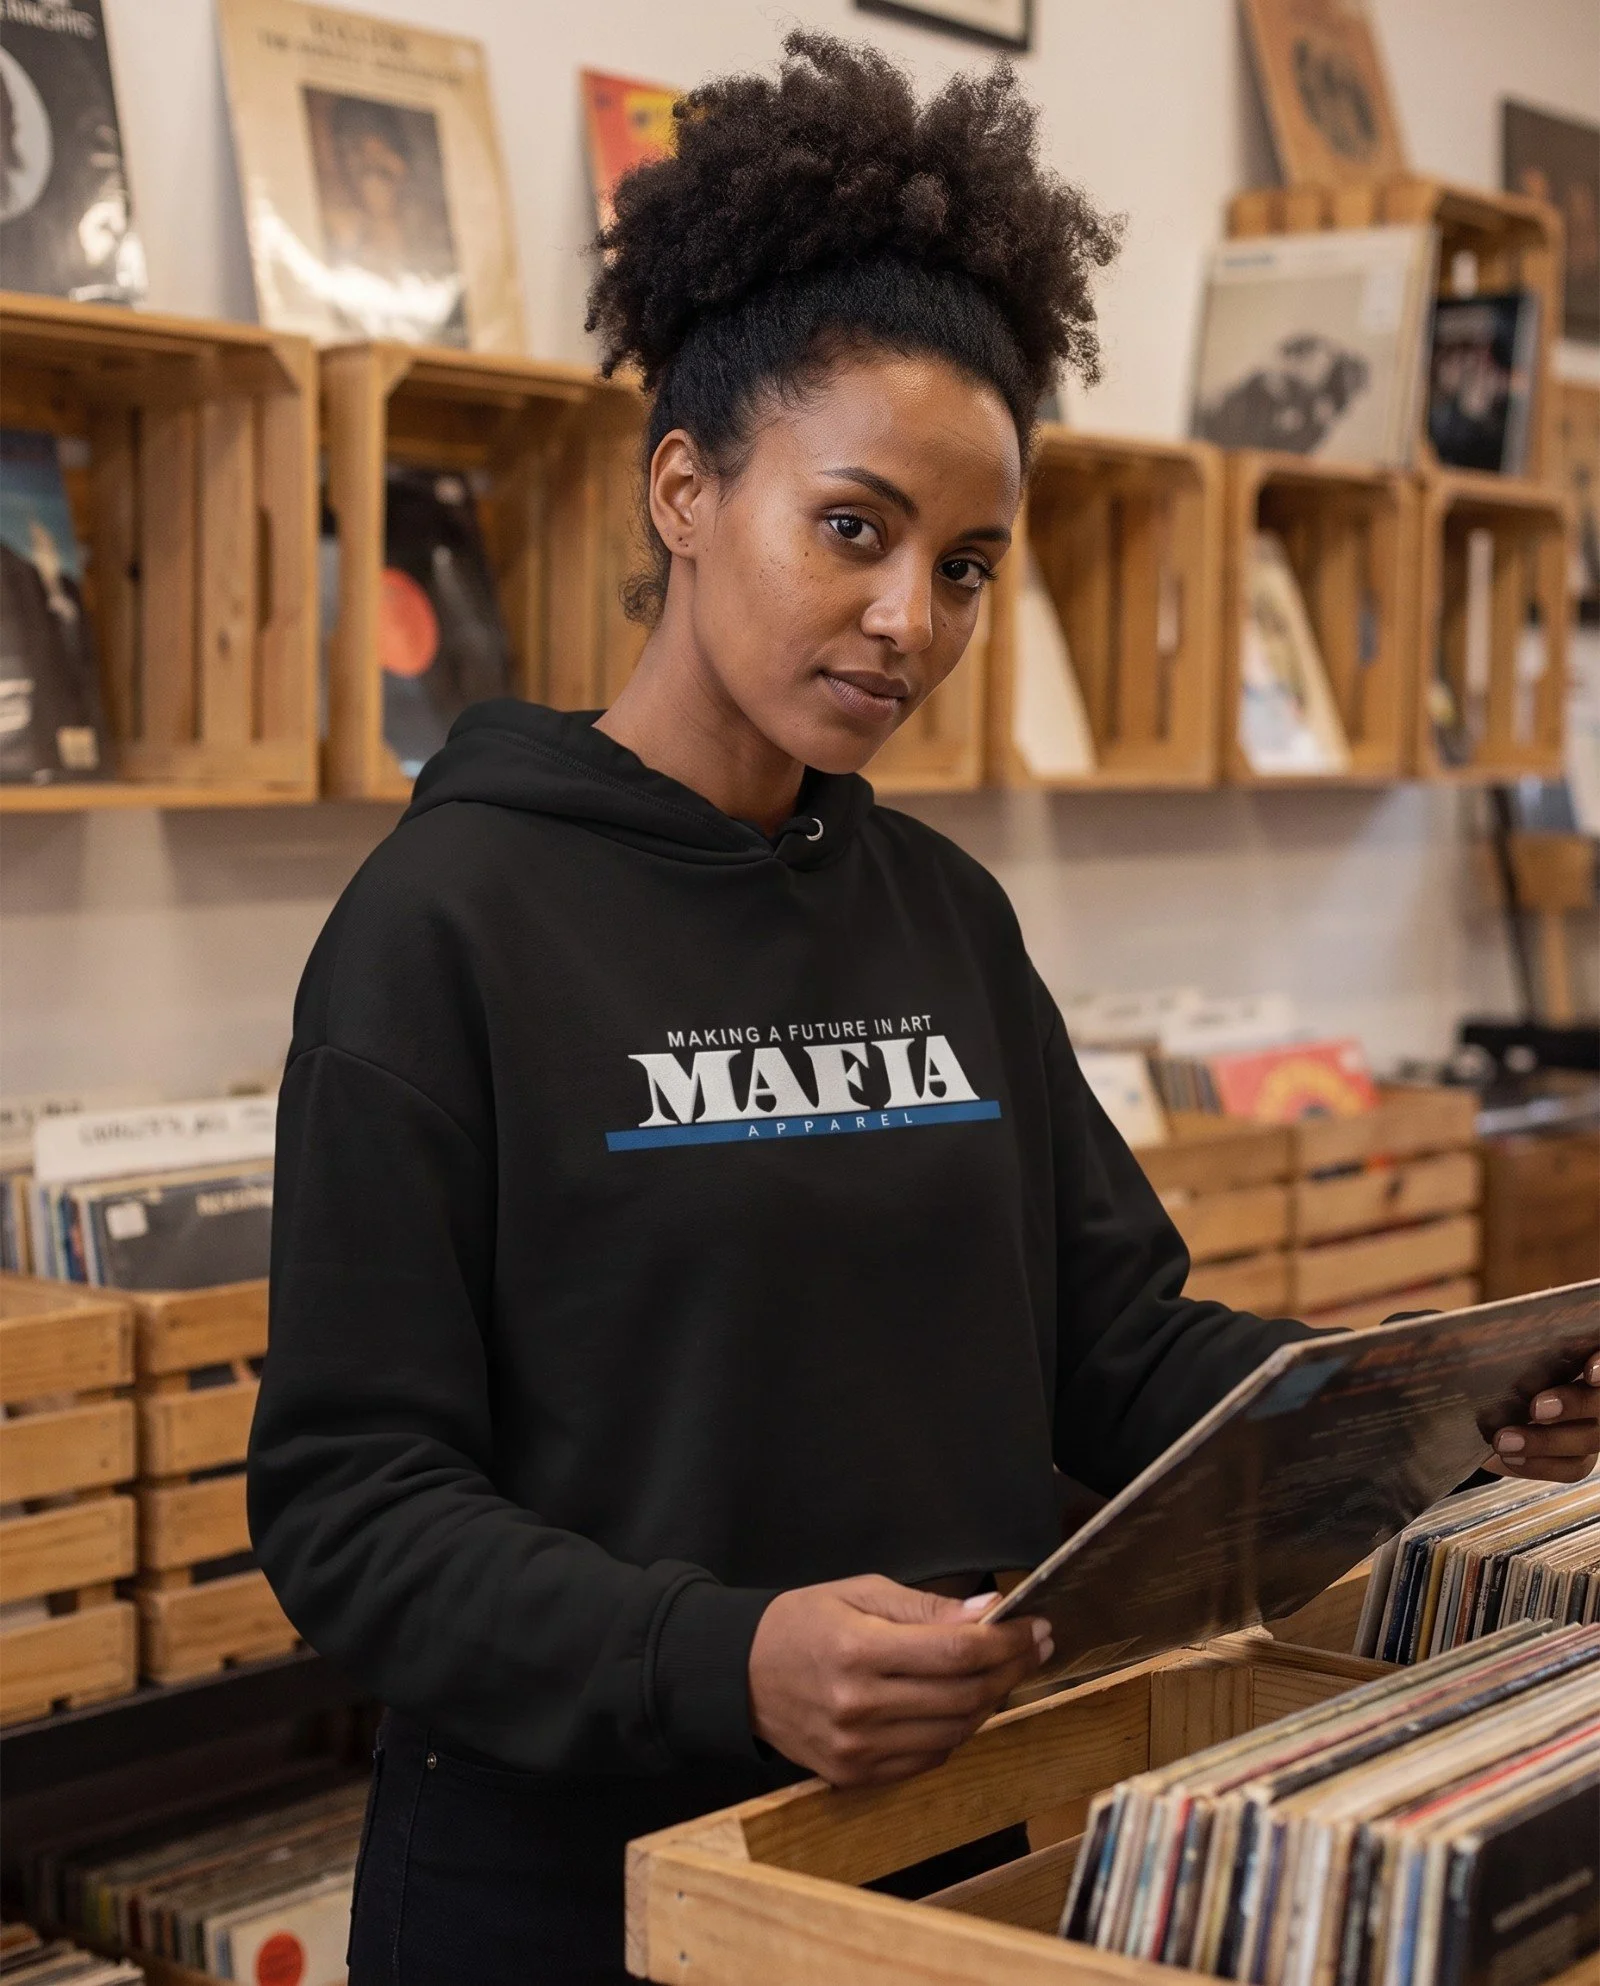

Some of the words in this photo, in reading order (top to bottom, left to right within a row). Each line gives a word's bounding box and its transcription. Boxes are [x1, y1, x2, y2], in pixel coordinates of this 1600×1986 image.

[666, 1026, 761, 1048] MAKING
[768, 1025, 782, 1042] A
[788, 1020, 868, 1041] FUTURE
[873, 1018, 893, 1035] IN
[900, 1014, 933, 1033] ART
[627, 1035, 981, 1128] MAFIA
[748, 1112, 913, 1137] APPAREL
